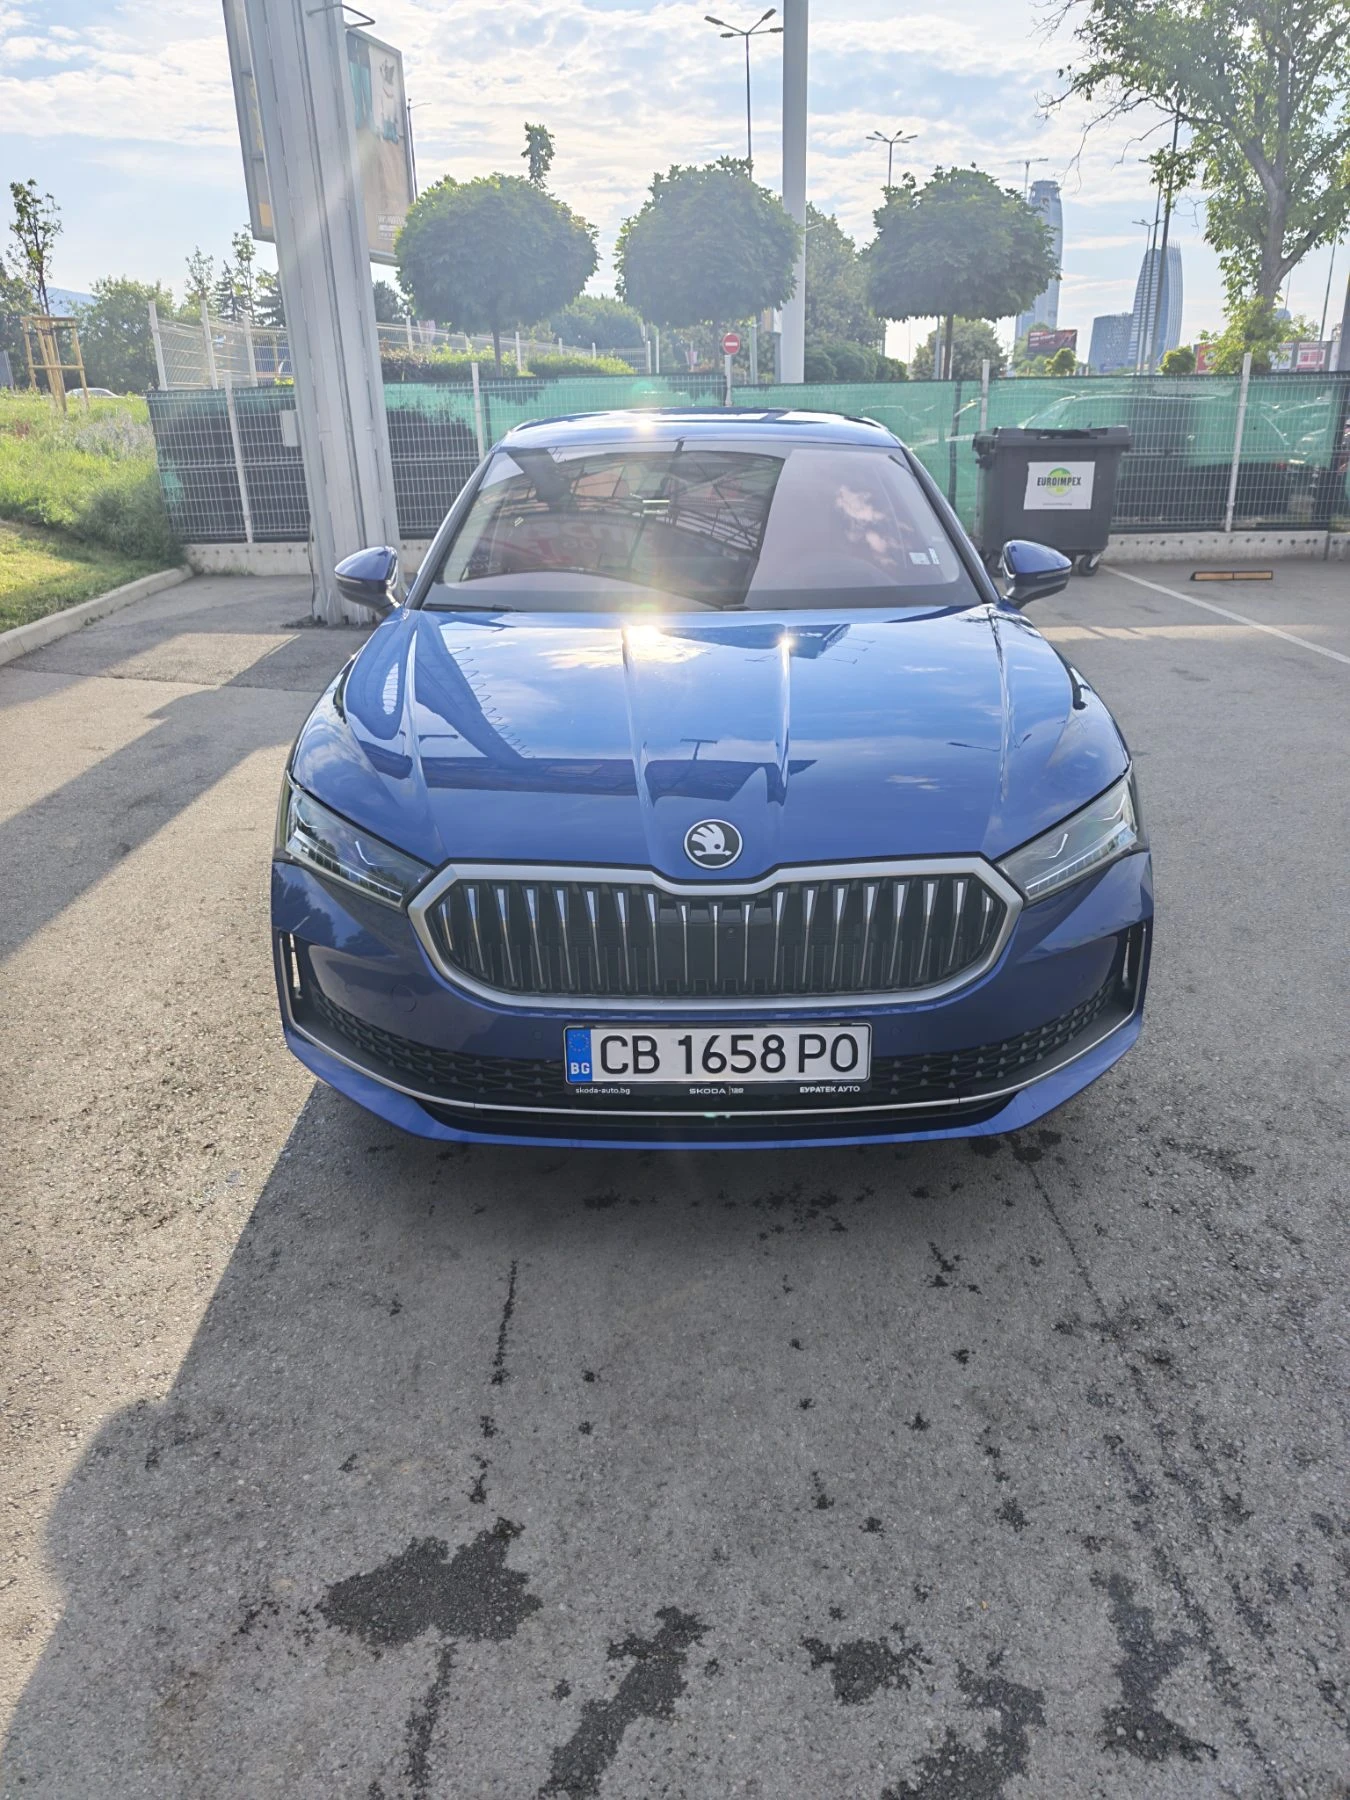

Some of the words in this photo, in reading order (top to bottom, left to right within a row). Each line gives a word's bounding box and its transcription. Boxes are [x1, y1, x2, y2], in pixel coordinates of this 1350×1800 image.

[1037, 477, 1081, 486] EUROIMPEX
[600, 1034, 660, 1075] CB
[677, 1033, 787, 1075] 1658
[798, 1032, 859, 1074] PO
[570, 1062, 590, 1075] BG
[575, 1086, 631, 1095] skoda-auto.bg
